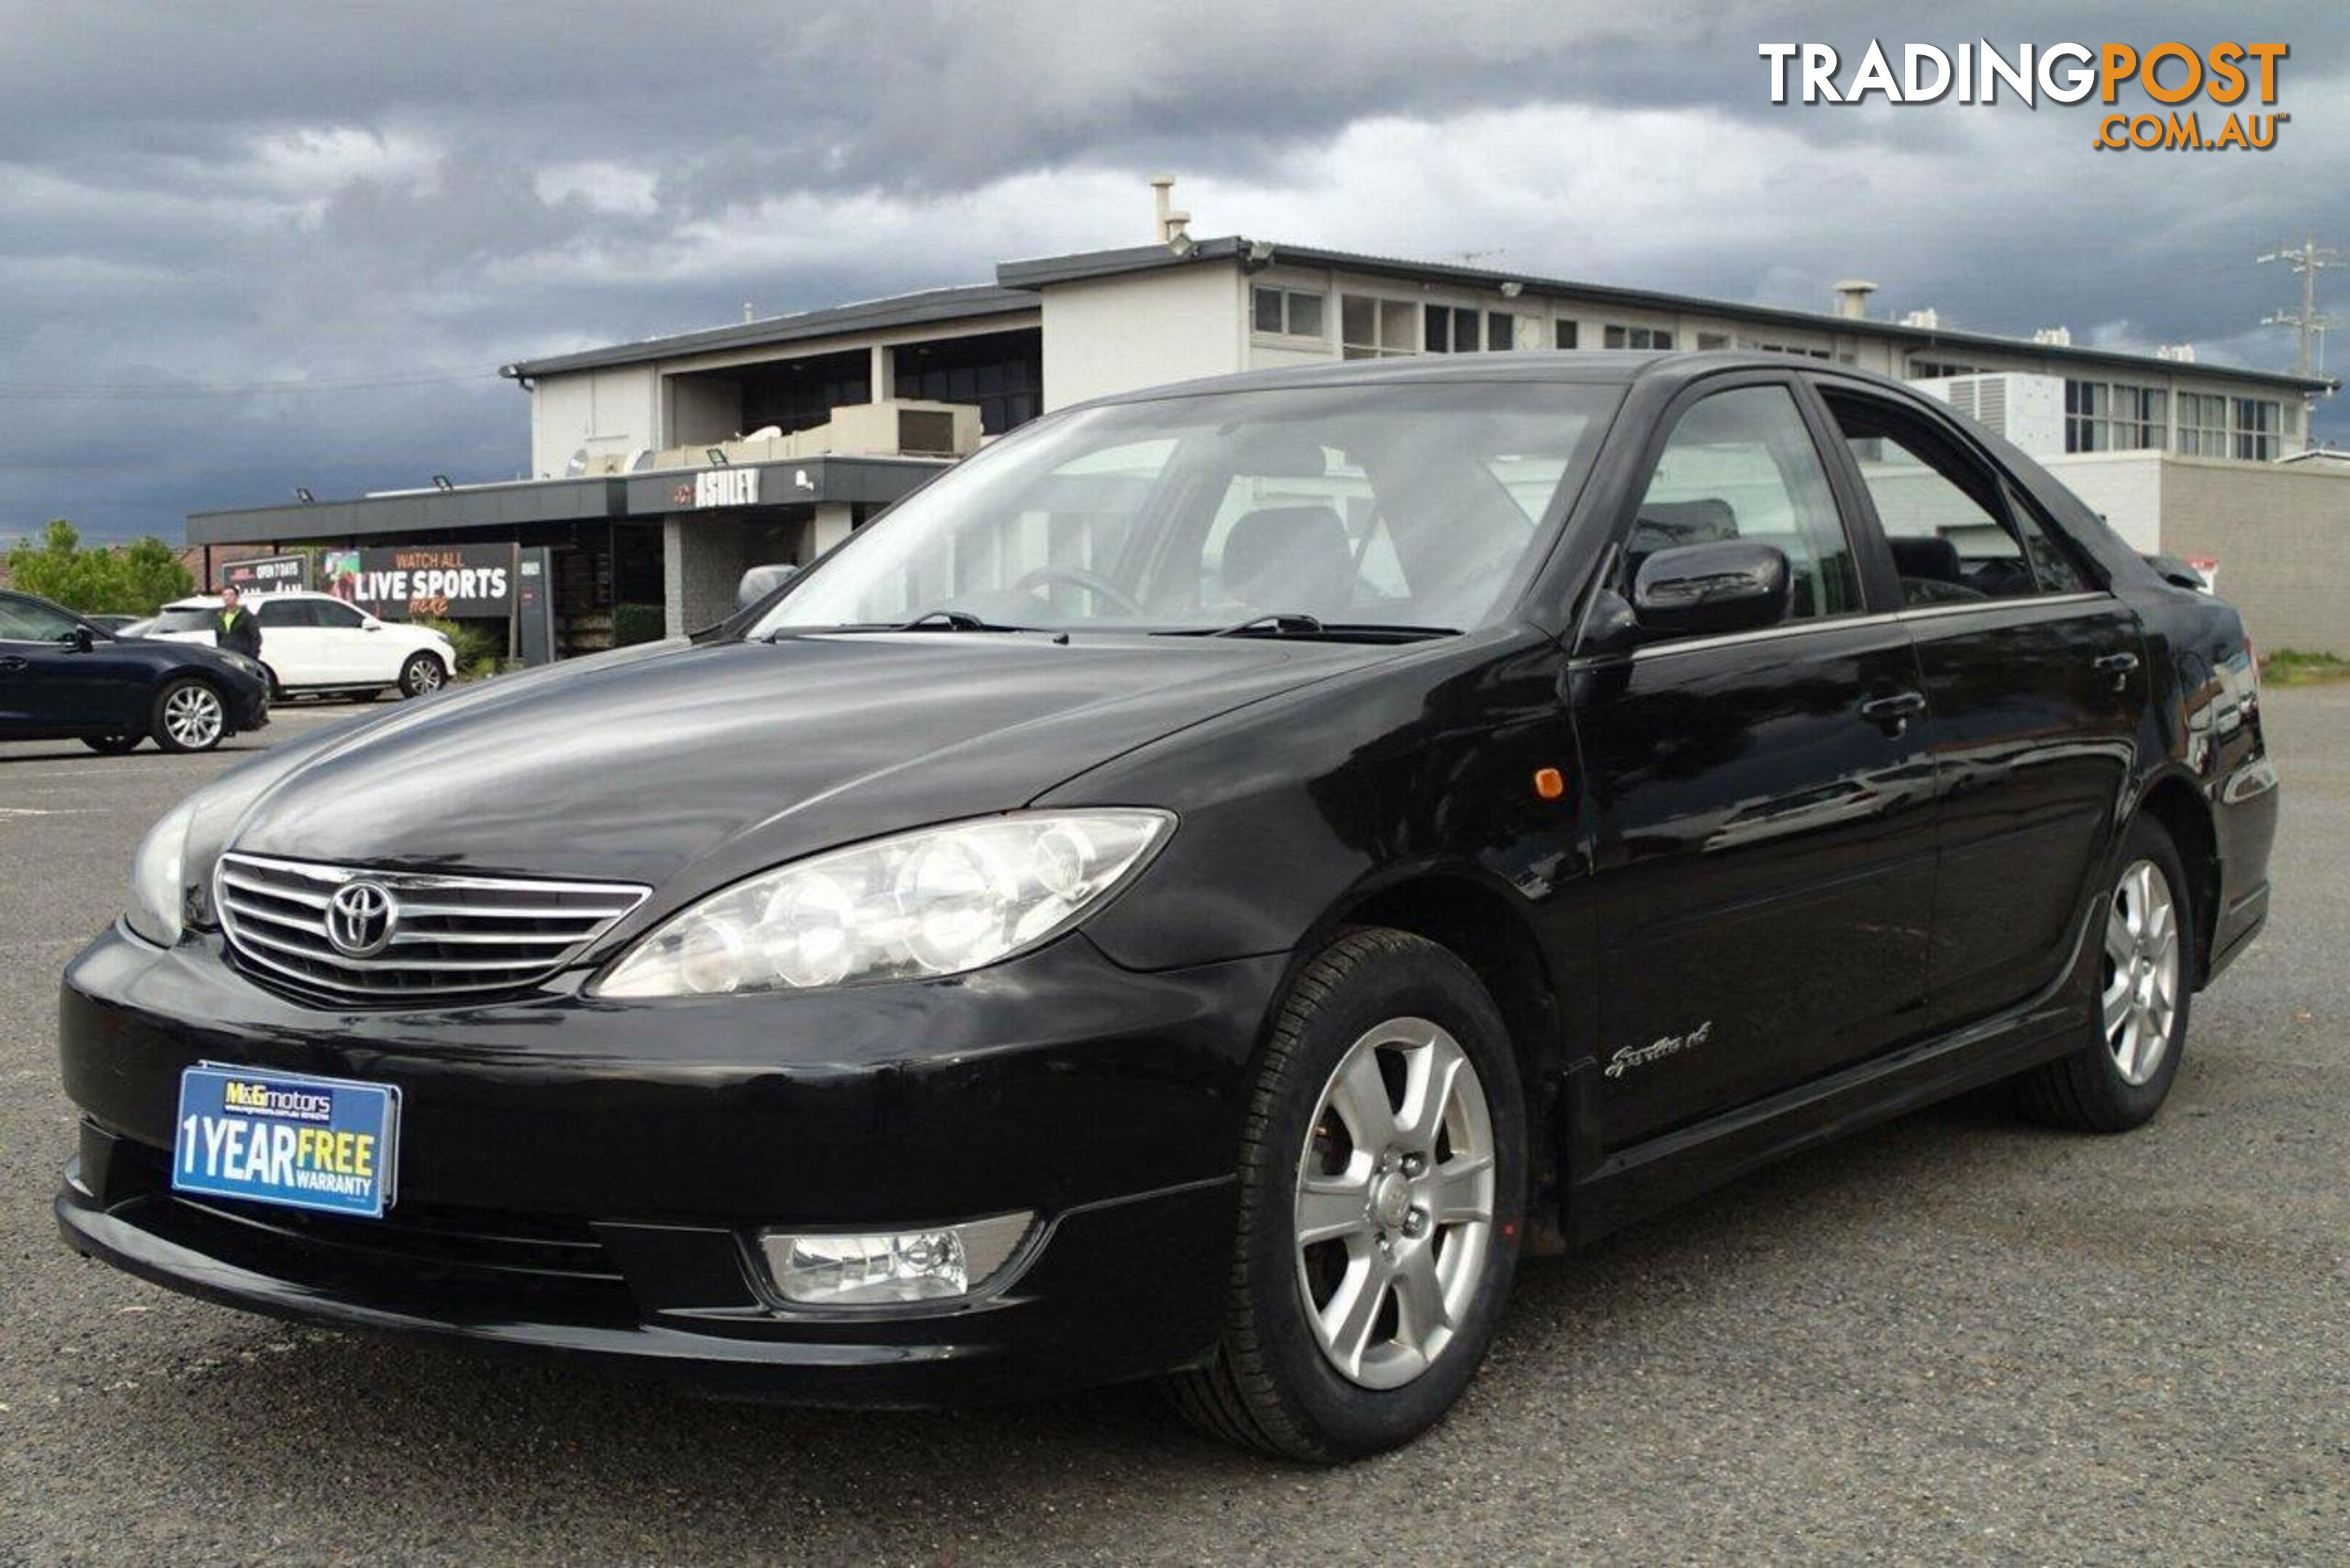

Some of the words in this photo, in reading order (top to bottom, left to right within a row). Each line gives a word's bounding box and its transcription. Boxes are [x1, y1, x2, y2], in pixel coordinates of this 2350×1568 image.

[396, 553, 438, 569] WATCH
[441, 552, 465, 568] ALL
[355, 571, 407, 601] LIVE
[412, 568, 507, 600] SPORTS
[184, 1114, 197, 1174] 1
[203, 1116, 296, 1188] YEAR
[296, 1127, 375, 1176] FREE
[296, 1169, 372, 1196] WARRANTY
